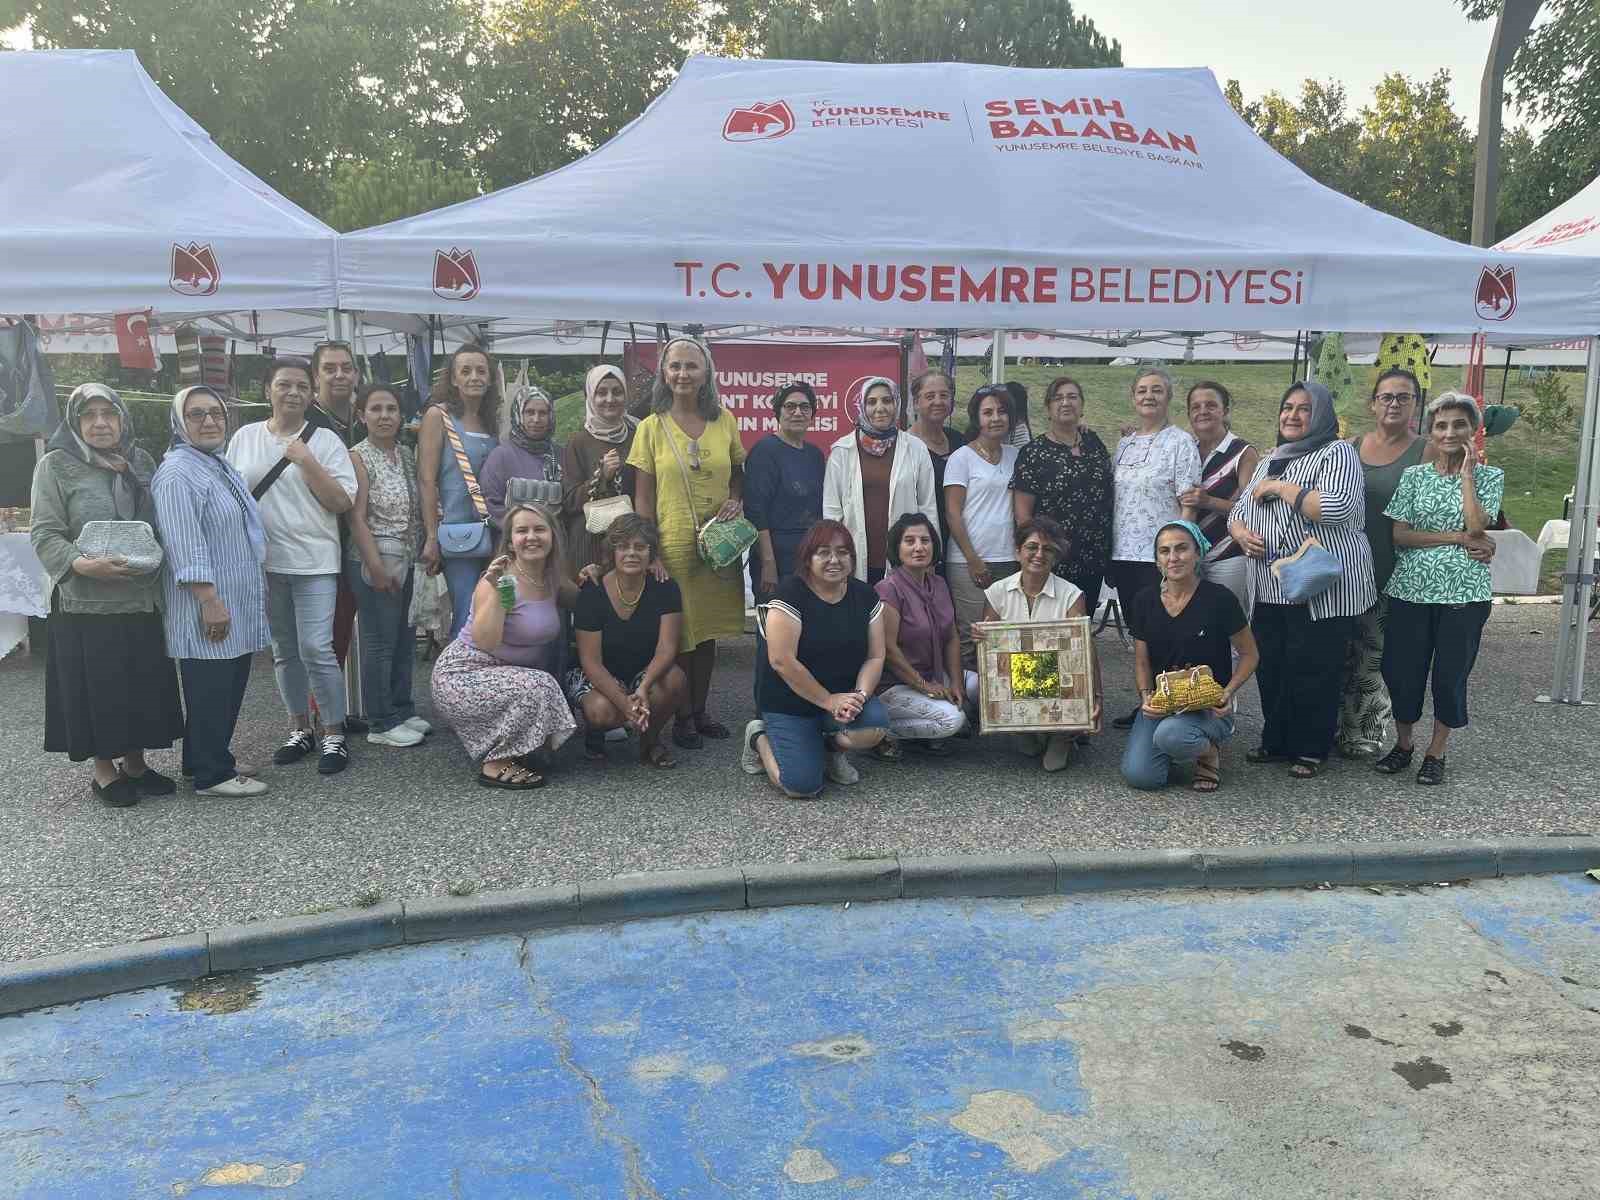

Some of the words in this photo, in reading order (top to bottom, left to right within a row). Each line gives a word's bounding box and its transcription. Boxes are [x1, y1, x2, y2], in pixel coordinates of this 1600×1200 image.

[812, 106, 951, 121] YUNUSEMRE
[989, 118, 1199, 155] BALABAN
[995, 143, 1081, 152] YUNUSEMRE
[674, 262, 753, 298] T.C.
[762, 263, 1057, 303] YUNUSEMRE
